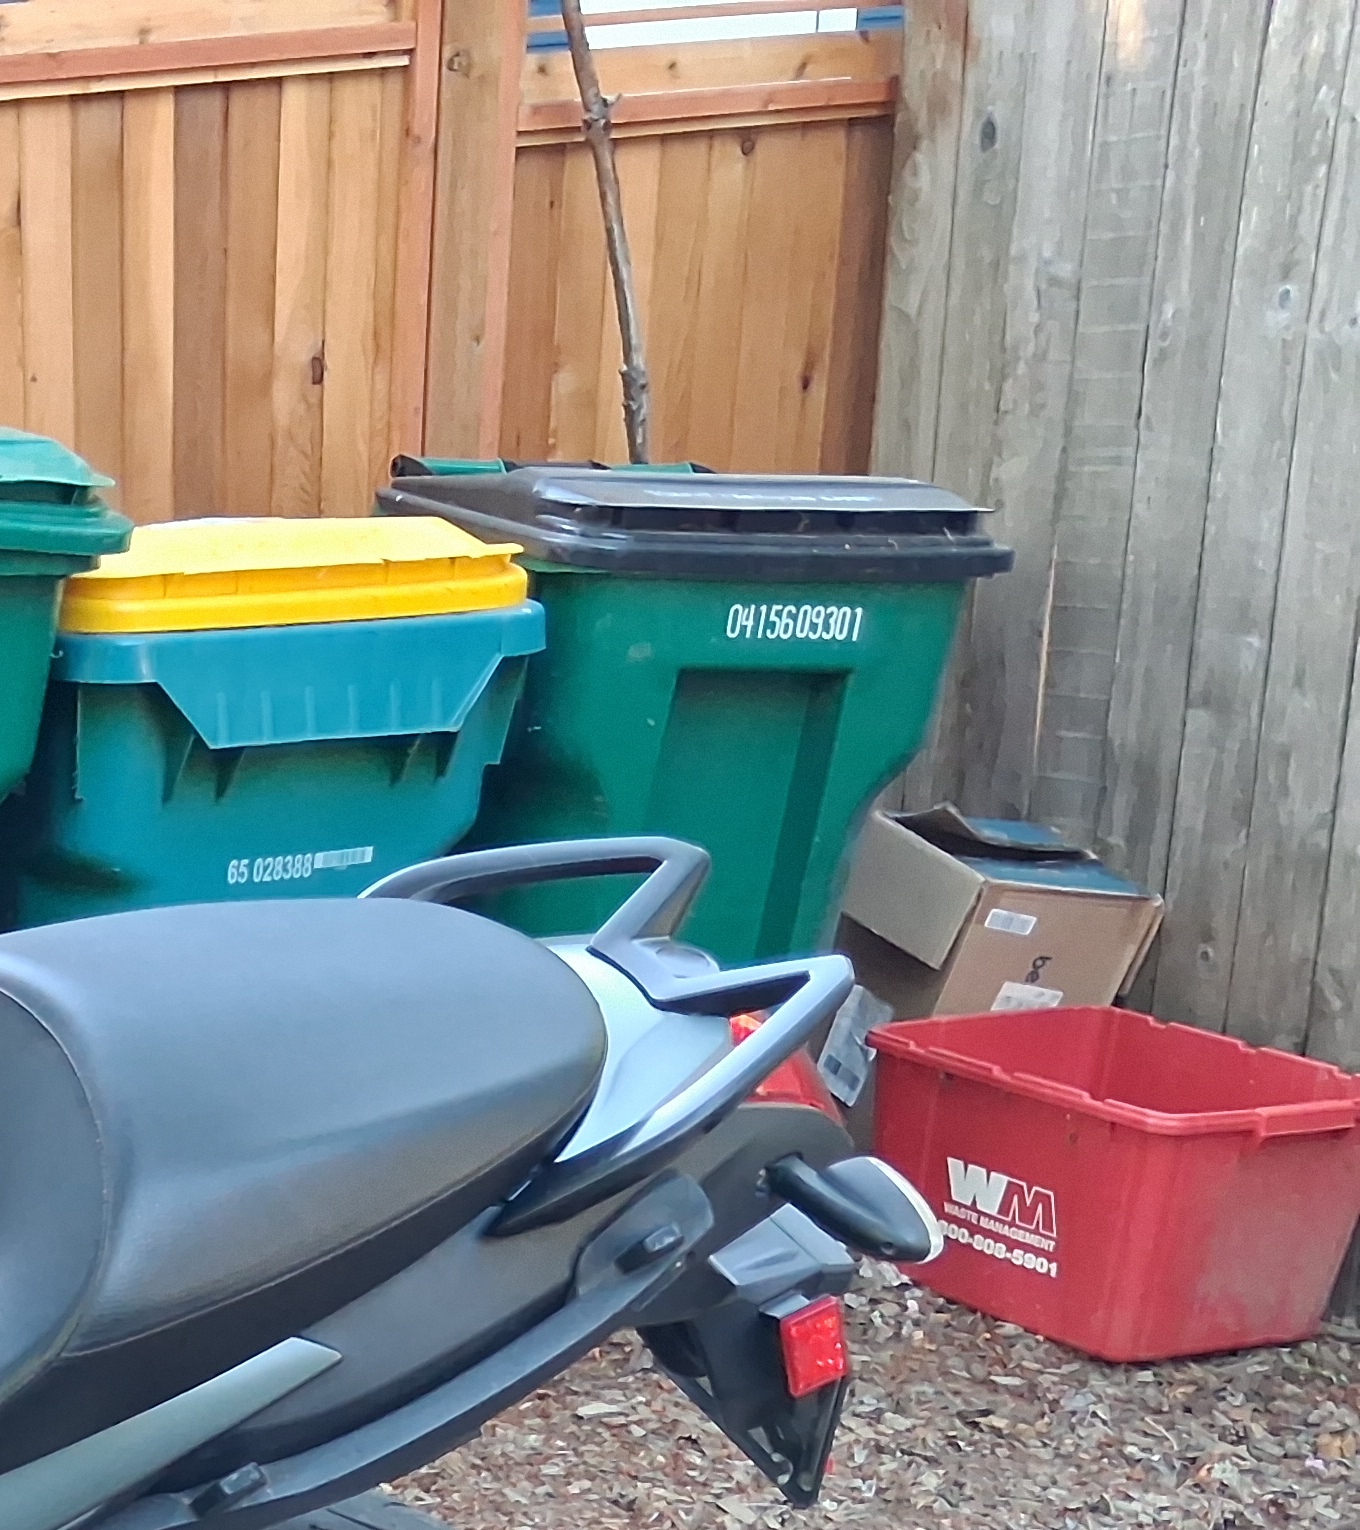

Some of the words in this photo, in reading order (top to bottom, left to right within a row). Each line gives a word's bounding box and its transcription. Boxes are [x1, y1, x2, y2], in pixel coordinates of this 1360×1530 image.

[726, 603, 864, 642] 0415609301
[227, 858, 250, 885] 65
[252, 853, 313, 883] 028388
[947, 1156, 1057, 1238] WM
[979, 1214, 1056, 1252] MANAGEMENT
